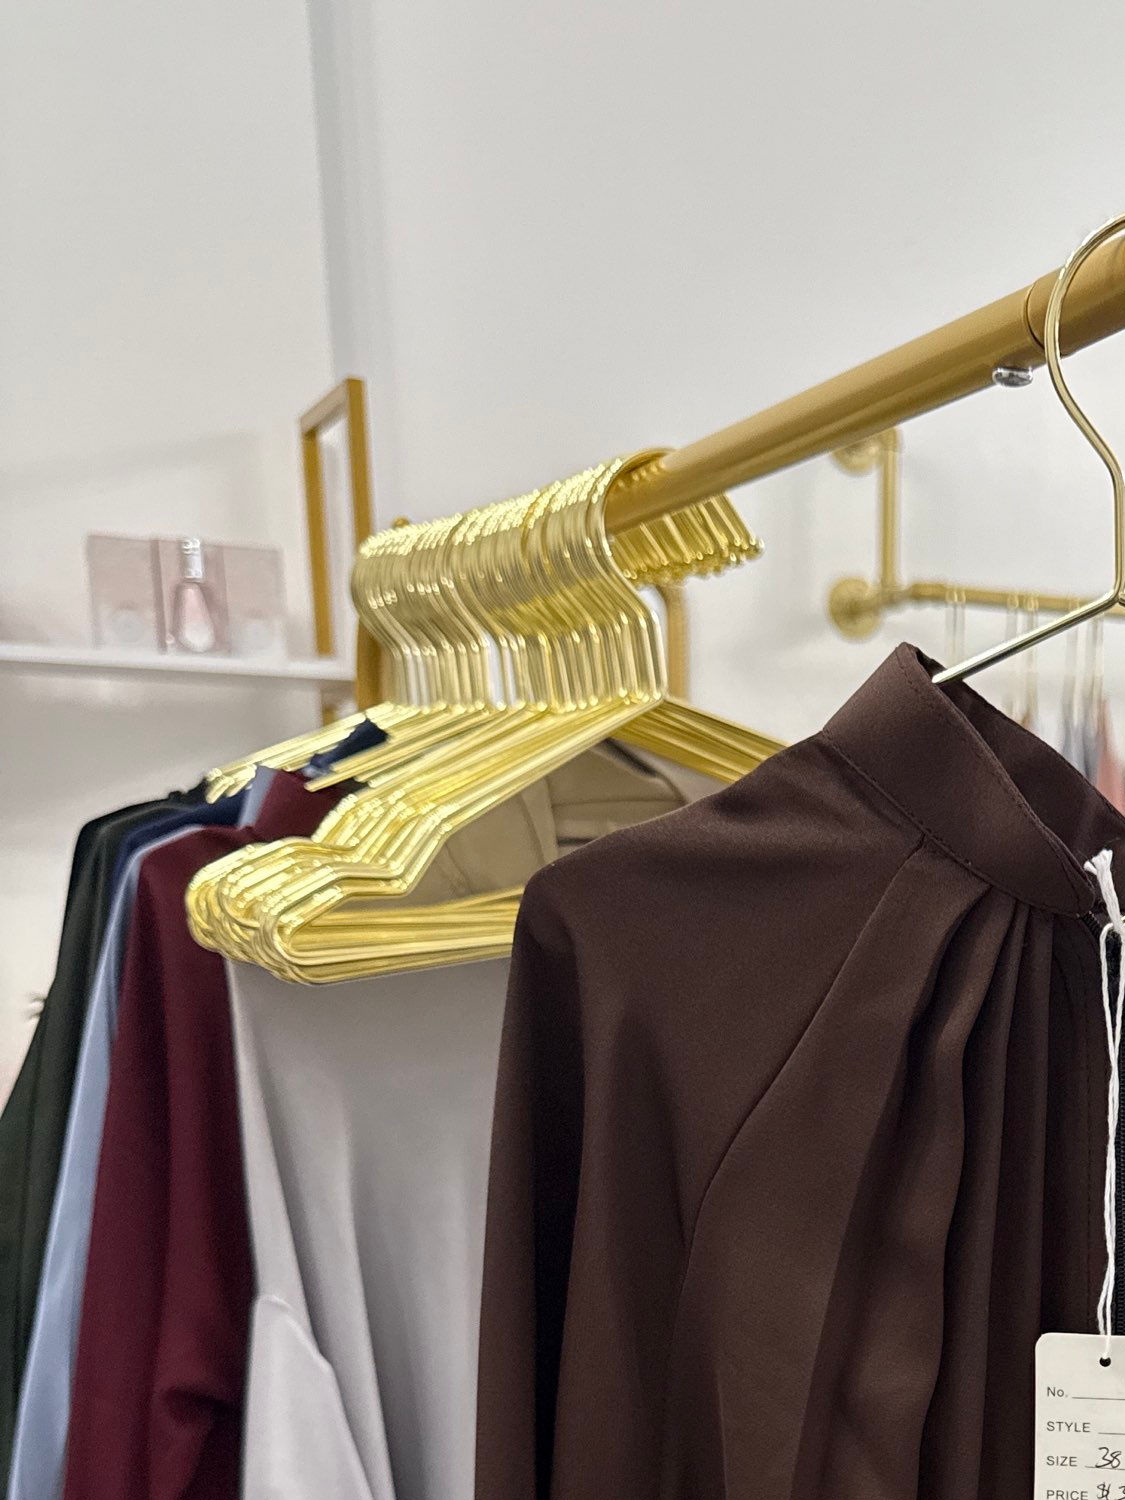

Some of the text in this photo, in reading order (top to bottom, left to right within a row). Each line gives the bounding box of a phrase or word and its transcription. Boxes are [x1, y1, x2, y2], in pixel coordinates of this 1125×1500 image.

[1046, 1386, 1068, 1398] No.
[1046, 1421, 1091, 1433] STYLE
[1046, 1446, 1122, 1469] SIZE 38
